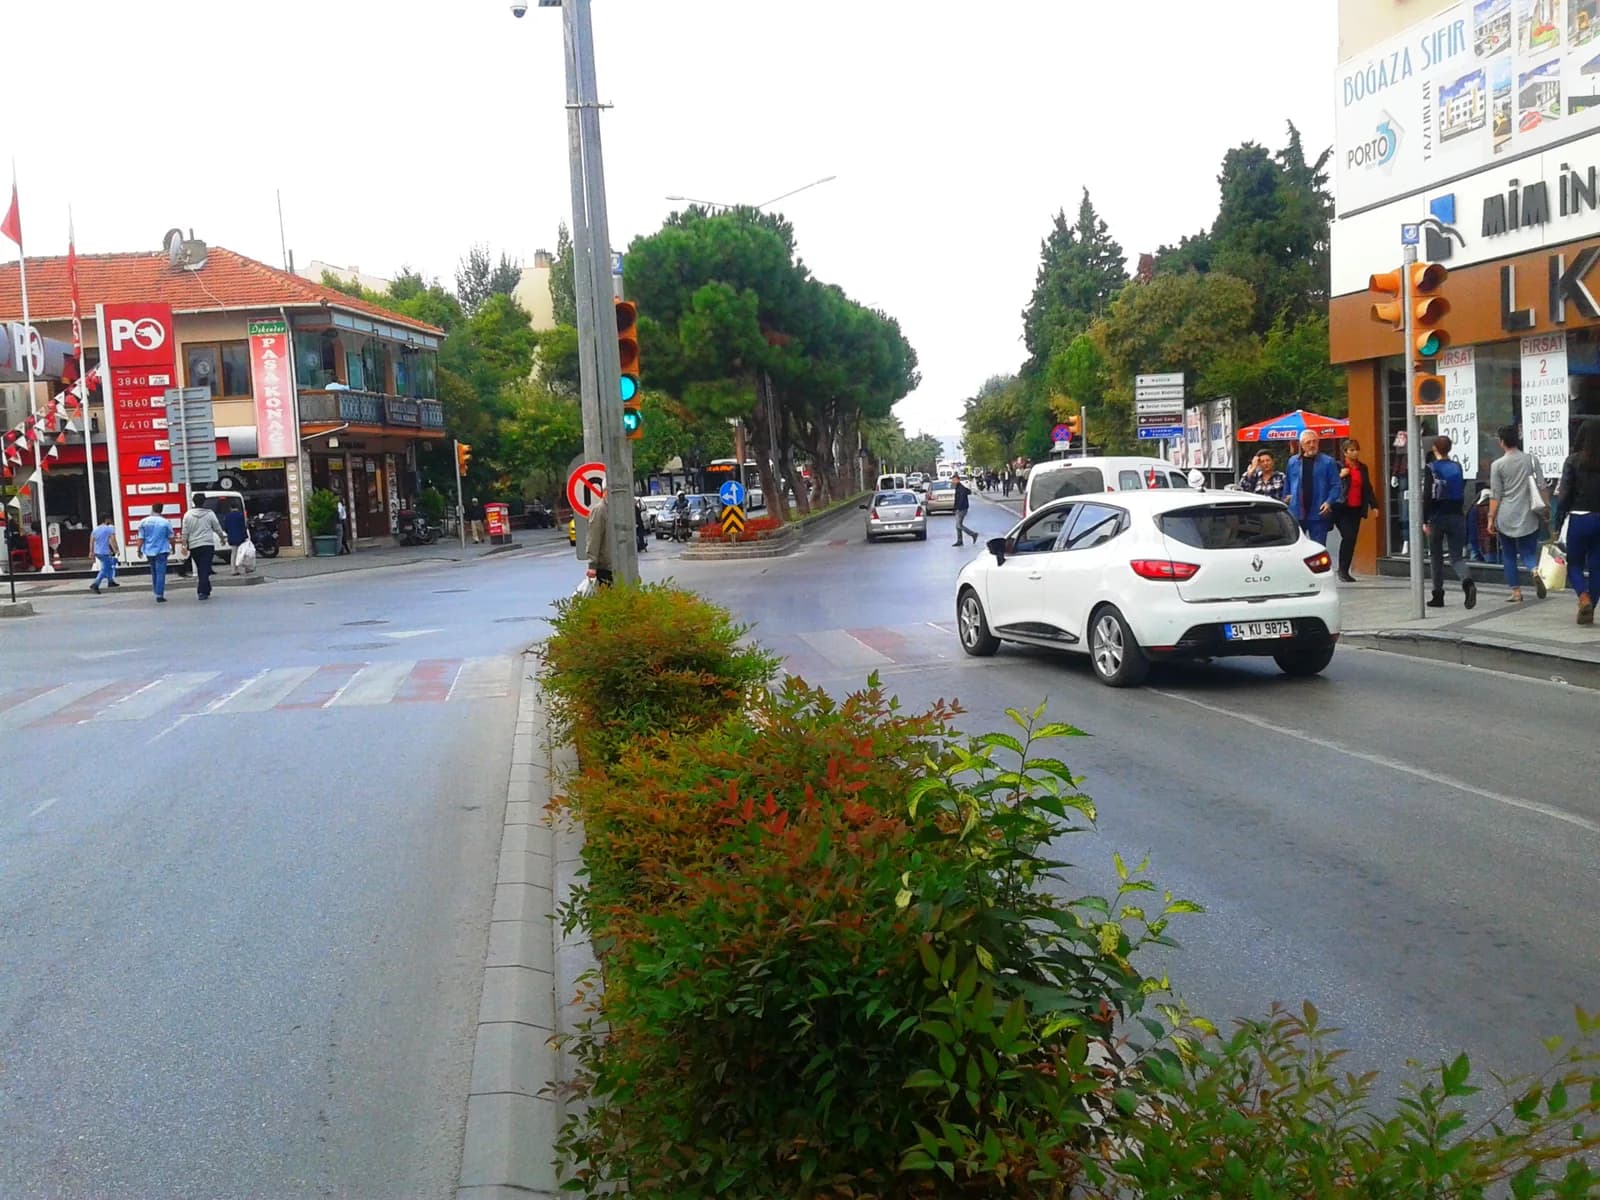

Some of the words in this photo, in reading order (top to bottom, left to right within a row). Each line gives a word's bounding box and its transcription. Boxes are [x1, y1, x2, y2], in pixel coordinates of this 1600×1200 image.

[1343, 45, 1413, 108] BOĞAZA
[1420, 18, 1466, 71] SIFIR
[1559, 162, 1600, 217] İN
[110, 317, 166, 352] PO
[1521, 333, 1565, 355] FIRSAT
[1540, 359, 1548, 374] 2
[1244, 575, 1271, 583] CLIO
[1231, 624, 1244, 637] 34
[1248, 623, 1262, 635] KU
[1264, 621, 1290, 634] 9875
